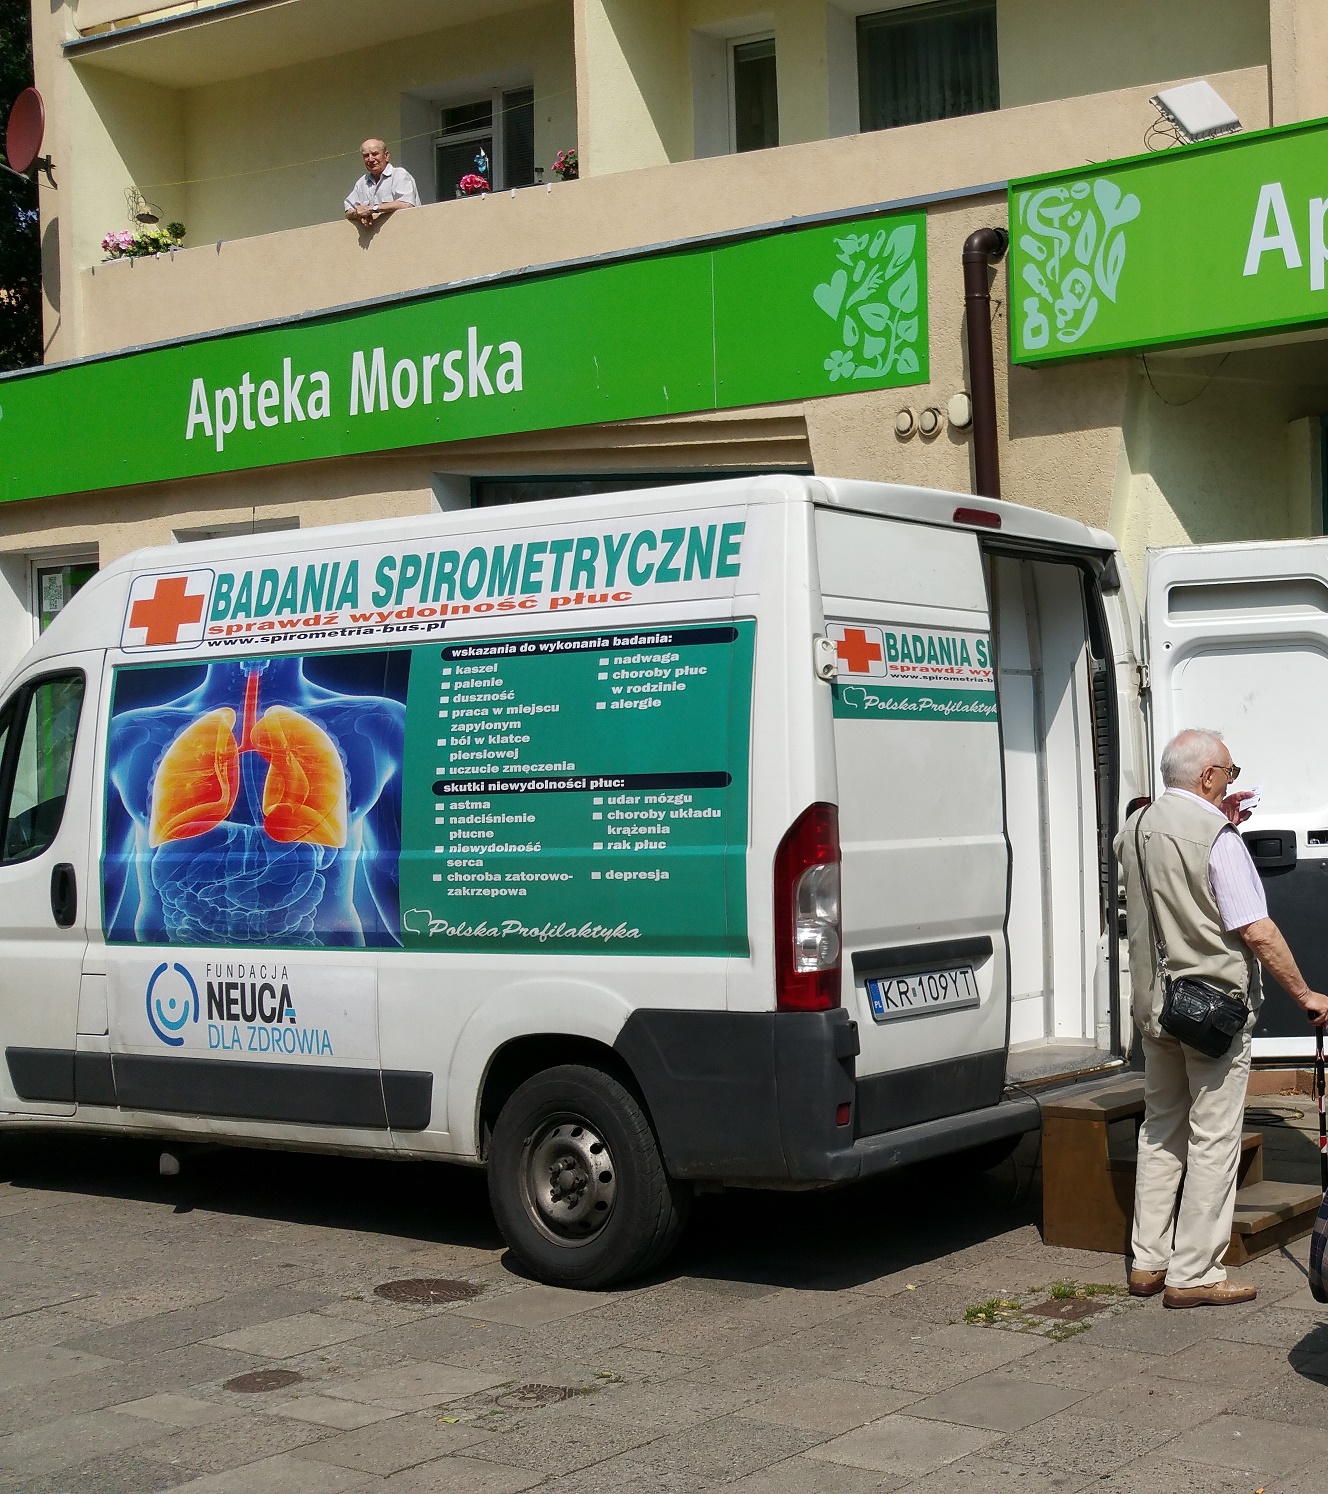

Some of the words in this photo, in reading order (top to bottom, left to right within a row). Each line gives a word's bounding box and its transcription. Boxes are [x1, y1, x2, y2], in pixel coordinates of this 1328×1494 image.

[184, 357, 332, 452] Apteka
[349, 326, 525, 417] Morska
[210, 559, 359, 622] BADANIA
[371, 521, 746, 609] SPIROMETRYCZNE
[208, 612, 339, 636] sprawdź
[349, 595, 538, 624] wydolność
[550, 591, 633, 610] płuc
[207, 620, 446, 648] www.spirometria-bus.pl
[451, 644, 517, 658] wskazania
[519, 643, 536, 653] do
[539, 637, 610, 652] wykonania
[612, 633, 673, 647] badania:
[885, 632, 973, 668] BADANIA
[613, 652, 680, 665] nadwaga
[455, 663, 499, 675] kaszel
[612, 666, 671, 679] choroby
[674, 665, 708, 678] płuc
[889, 664, 965, 676] sprawdź
[453, 677, 504, 690] palenie
[611, 686, 623, 695] w
[626, 681, 687, 694] rodzinie
[452, 690, 515, 703] duszność
[610, 697, 662, 710] alergie
[451, 707, 489, 720] praca
[492, 708, 503, 716] w
[506, 703, 560, 716] miejscu
[450, 720, 521, 733] zapylonym
[450, 735, 471, 746] ból
[474, 737, 485, 745] w
[488, 733, 531, 745] klatce
[449, 747, 519, 762] piersiowej
[449, 763, 500, 775] uczucie
[502, 760, 576, 774] zmęczenia
[443, 781, 485, 793] skutki
[488, 778, 587, 793] niewydolności
[589, 777, 625, 790] płuc:
[449, 799, 491, 810] astma
[607, 794, 641, 805] udar
[644, 792, 693, 805] mózgu
[449, 812, 536, 825] nadciśnienie
[607, 809, 667, 821] choroby
[669, 807, 722, 819] układu
[449, 829, 495, 841] płucne
[607, 824, 671, 837] krążenia
[448, 842, 542, 855] niewydolność
[607, 840, 632, 850] rak
[634, 839, 667, 852] płuc
[446, 858, 484, 868] serca
[446, 872, 502, 882] choroba
[504, 871, 574, 882] zatorowo-
[605, 869, 670, 882] depresja
[447, 886, 527, 898] zakrzepowa
[206, 963, 289, 980] FUNDACJA
[206, 981, 297, 1025] NEUCA
[874, 1001, 883, 1009] PL
[208, 1023, 243, 1051] DLA
[247, 1025, 334, 1056] ZDROWIA
